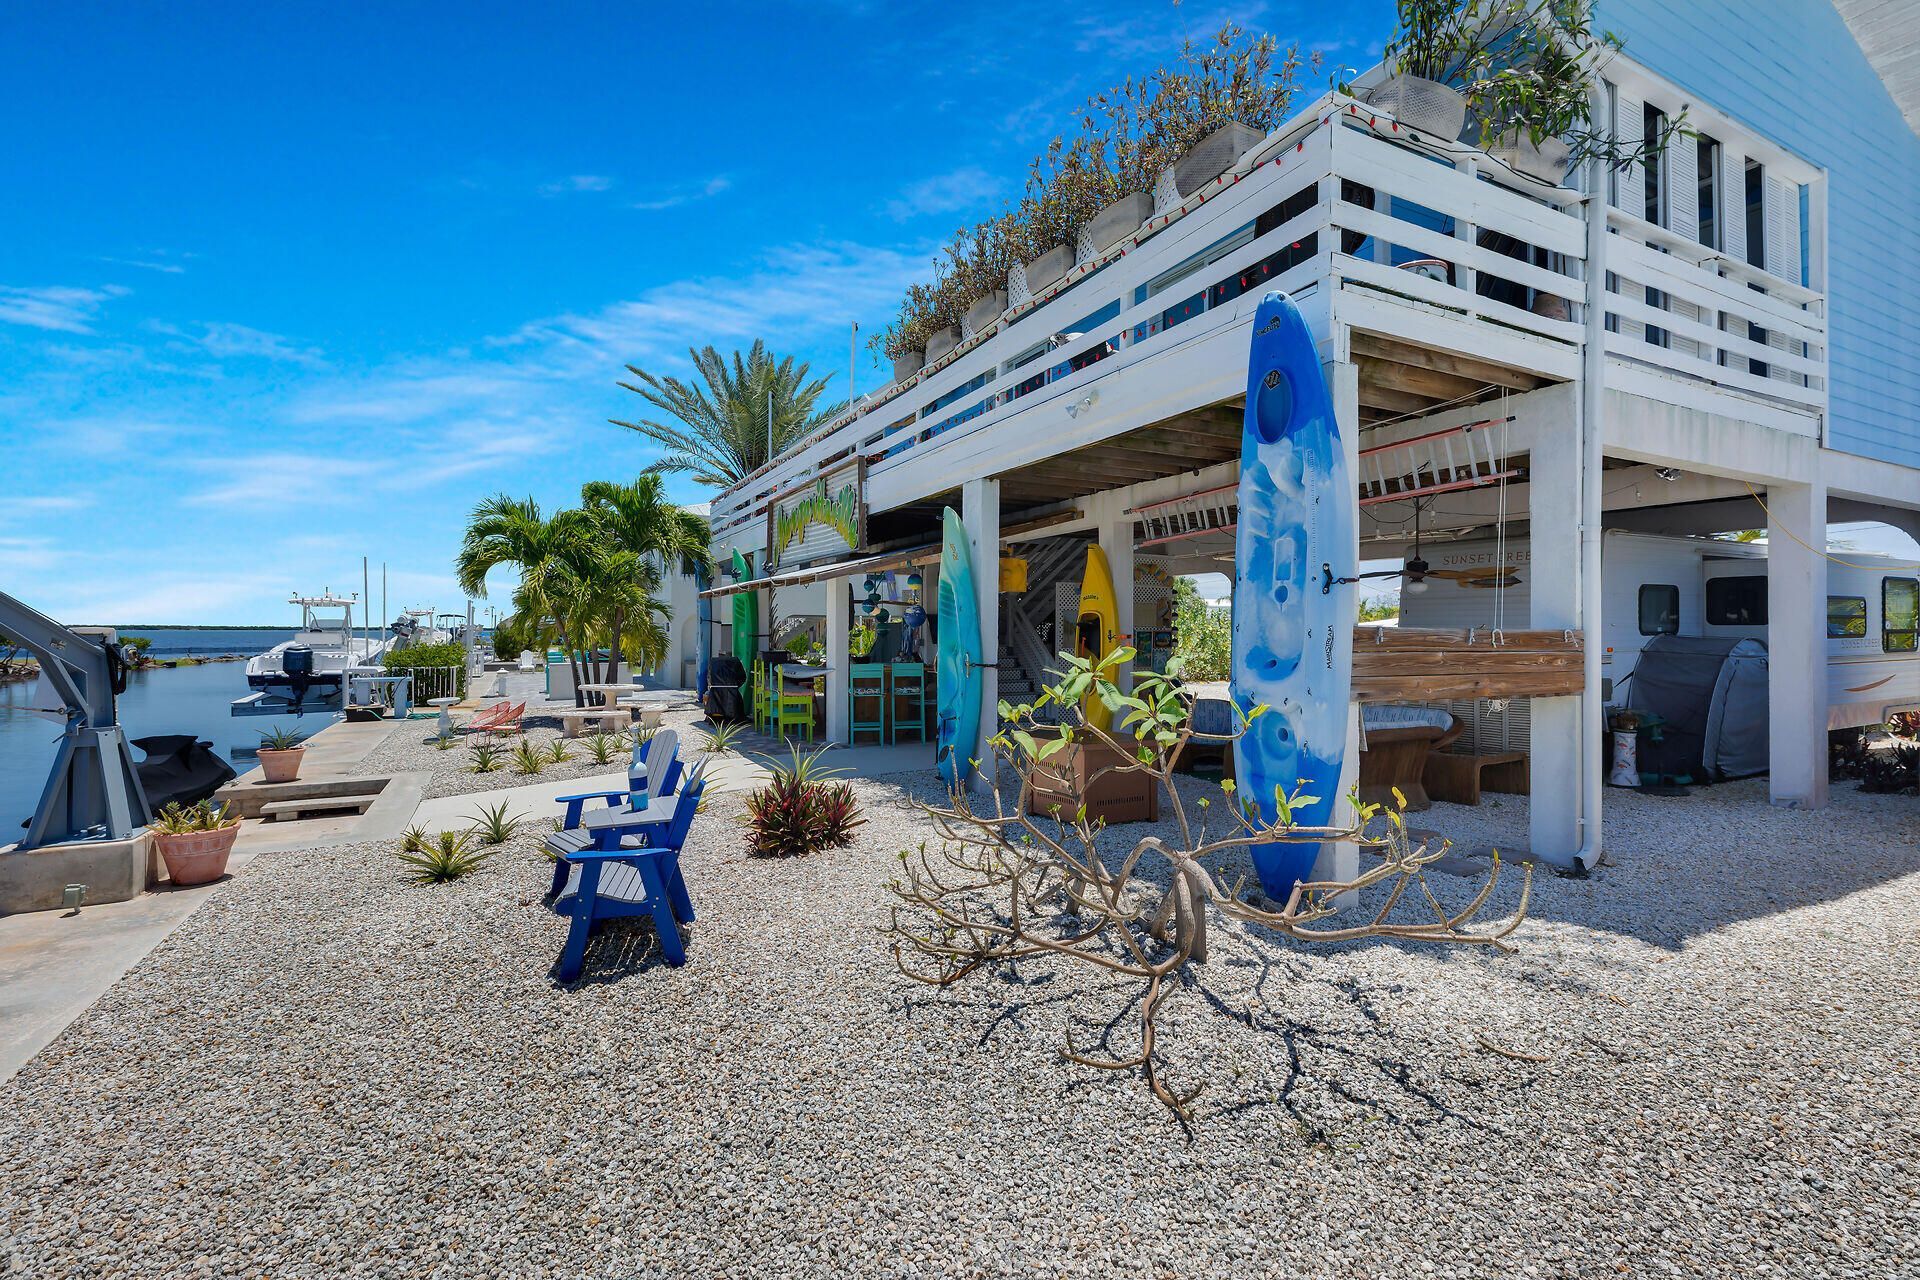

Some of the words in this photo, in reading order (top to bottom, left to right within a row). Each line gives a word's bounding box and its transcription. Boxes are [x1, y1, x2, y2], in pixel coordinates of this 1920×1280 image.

[1443, 553, 1494, 566] SUNSET
[1495, 551, 1531, 563] CREE
[1324, 624, 1334, 670] MAINSTREAM
